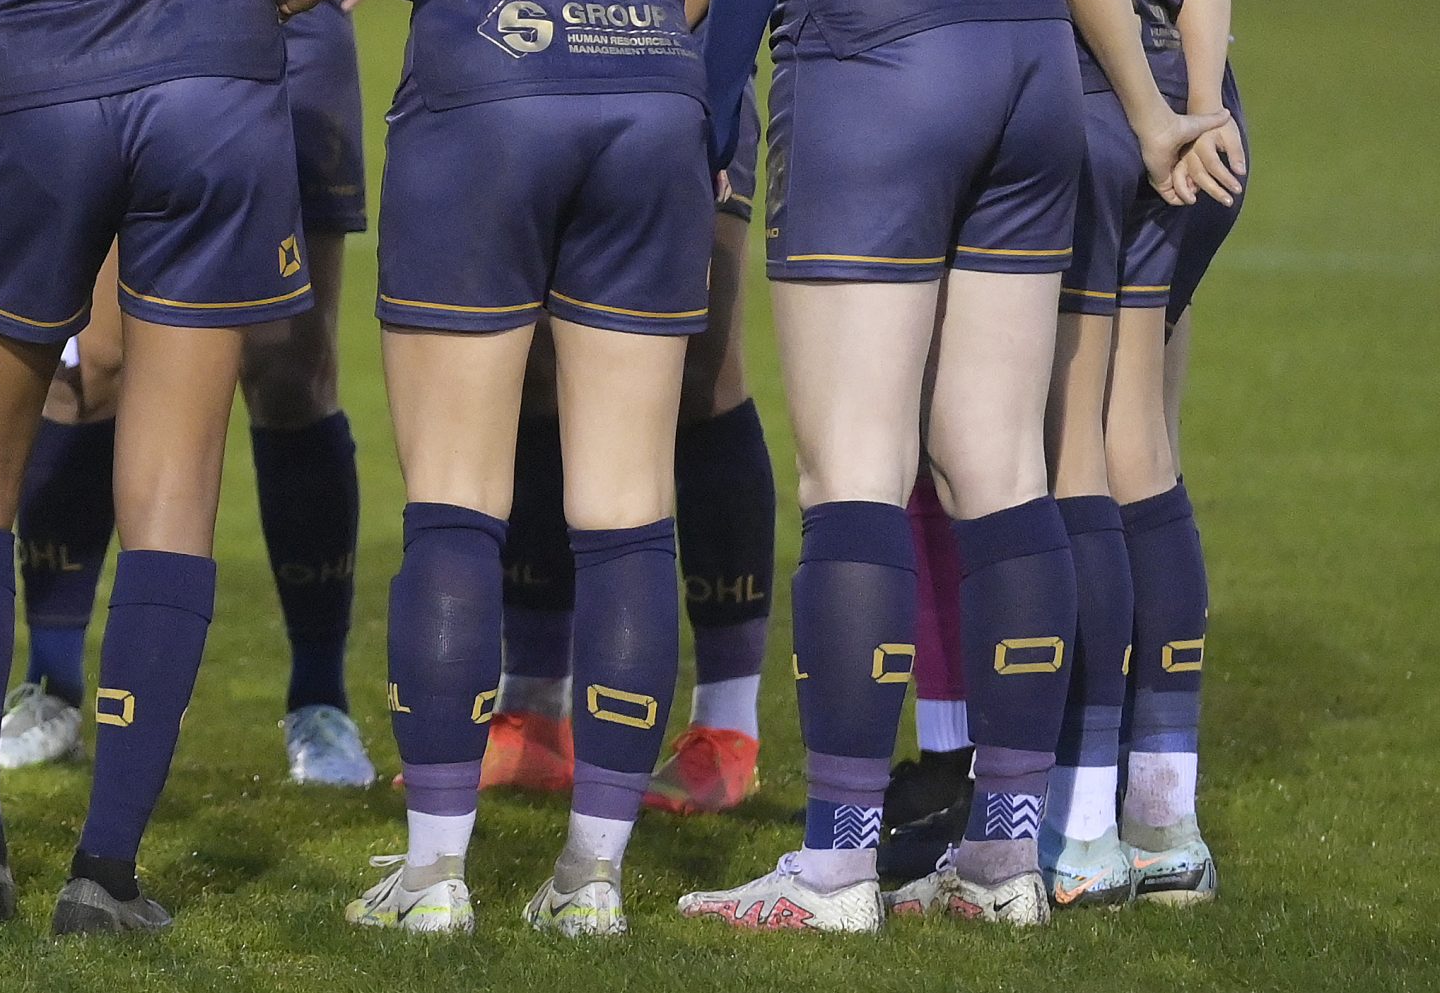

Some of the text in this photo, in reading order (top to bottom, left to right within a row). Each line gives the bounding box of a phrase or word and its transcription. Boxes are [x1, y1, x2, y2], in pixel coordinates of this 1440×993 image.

[561, 1, 667, 28] GROUP
[567, 33, 608, 45] HUMAN
[610, 36, 672, 47] RESOURCES
[568, 44, 646, 56] MANAGEMENT
[684, 573, 765, 605] OHL
